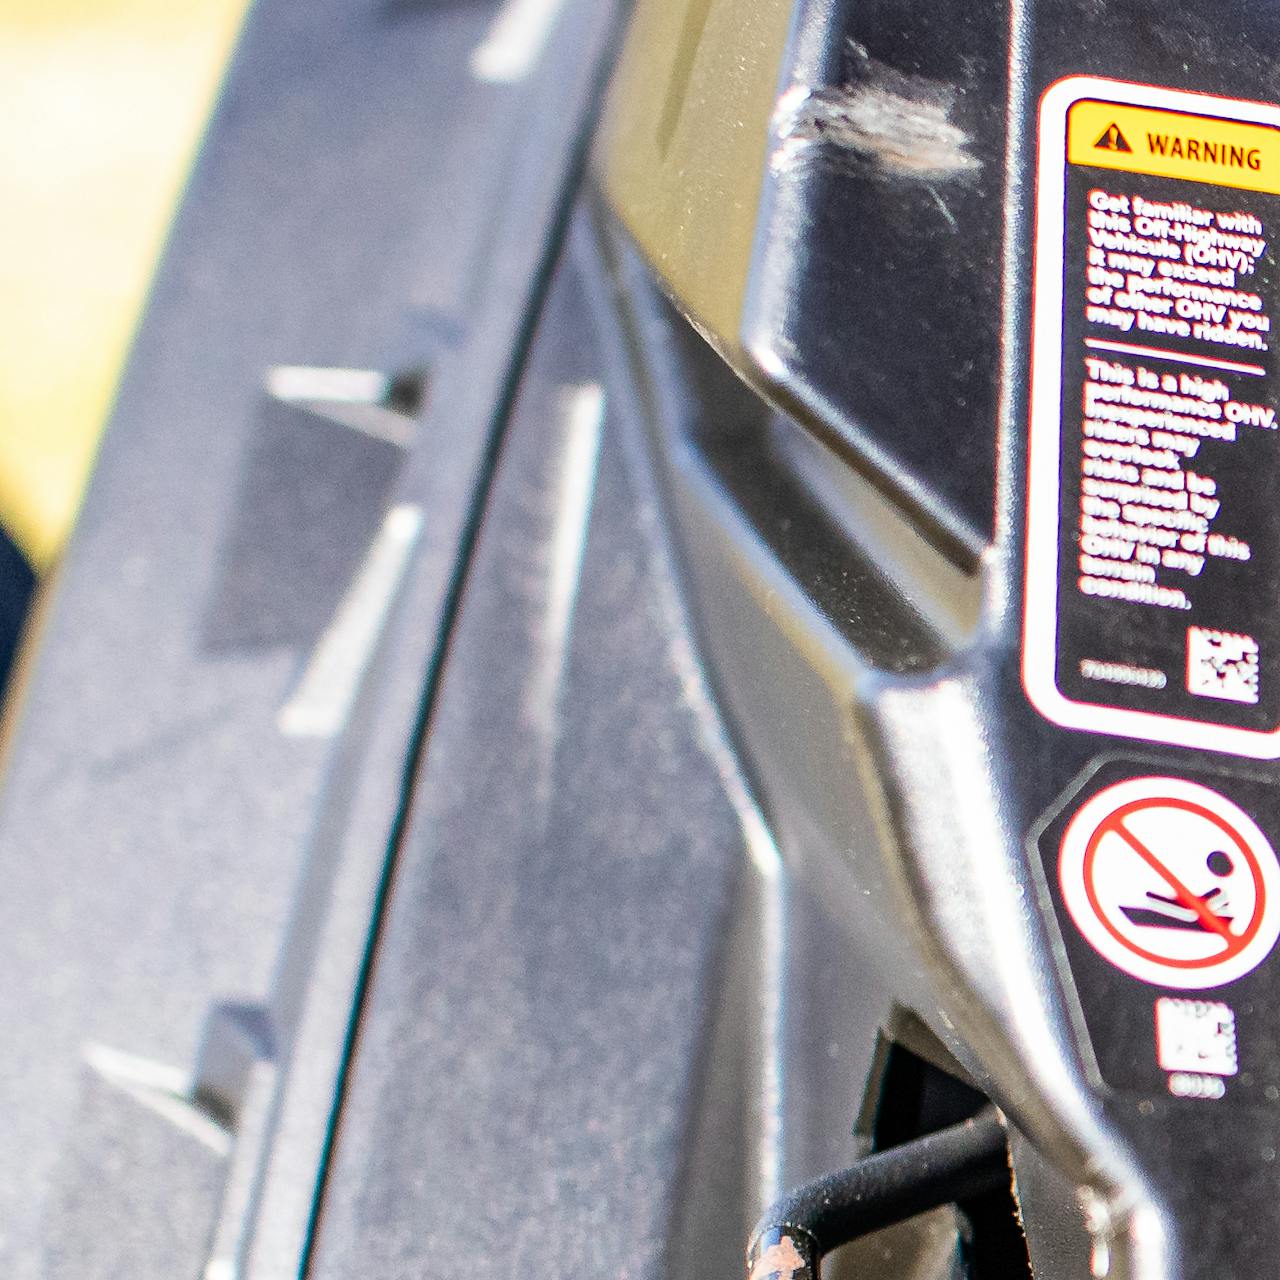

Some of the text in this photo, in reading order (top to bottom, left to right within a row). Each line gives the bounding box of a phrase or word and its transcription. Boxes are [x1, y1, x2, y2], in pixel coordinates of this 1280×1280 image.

[1147, 132, 1262, 171] WARNING
[1088, 190, 1262, 234] Get familiar with
[1089, 210, 1266, 257] this Off-Highway
[1088, 266, 1262, 310] the performance
[1108, 253, 1155, 277] may
[1158, 261, 1235, 287] exceed
[1086, 287, 1269, 332] of other OHV you
[1086, 306, 1268, 351] may have ridden.
[1085, 358, 1229, 402] This is a high
[1225, 401, 1278, 429] OHV.
